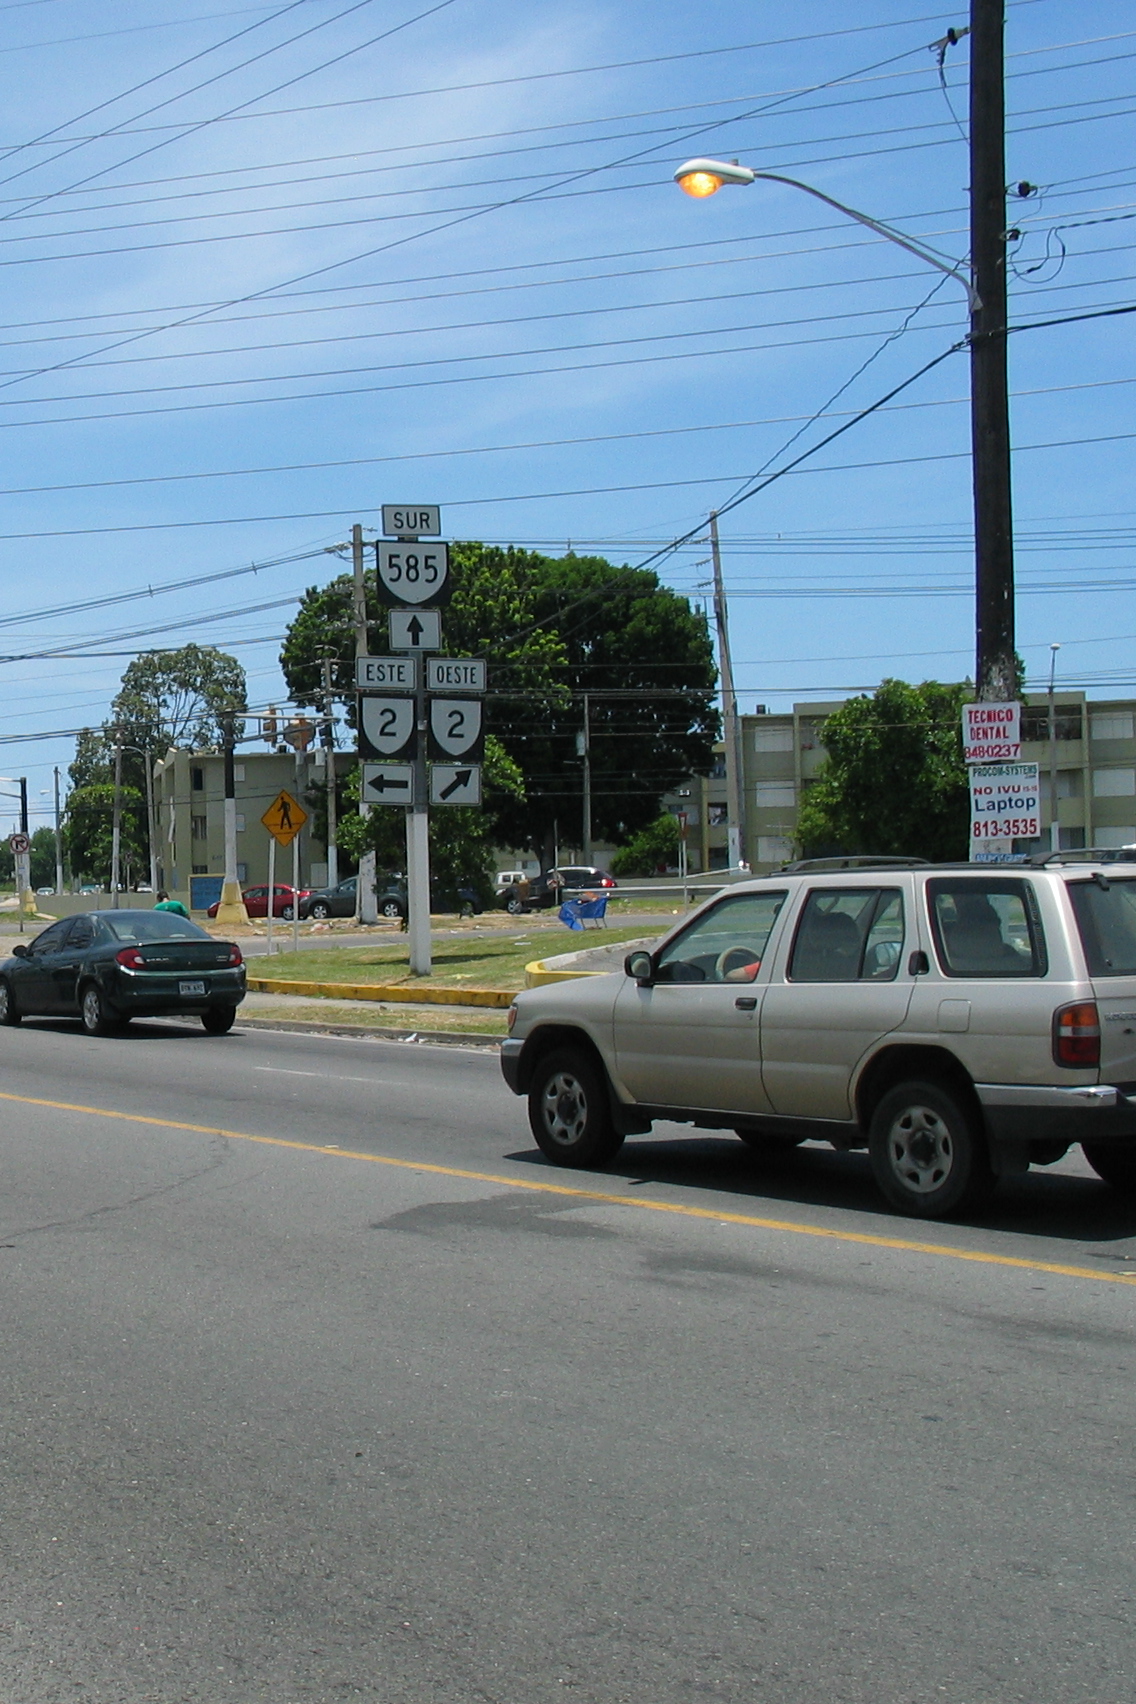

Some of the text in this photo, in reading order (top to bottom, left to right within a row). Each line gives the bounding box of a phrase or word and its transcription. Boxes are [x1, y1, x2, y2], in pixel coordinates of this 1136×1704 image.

[393, 512, 431, 530] SUR
[387, 554, 439, 584] 585
[365, 664, 407, 683] ESTE
[436, 665, 478, 685] OESTE
[378, 708, 398, 738] 2
[447, 709, 466, 739] 2
[967, 708, 1014, 725] TECNICO
[969, 726, 1010, 741] DENTAL
[973, 786, 993, 796] NO
[998, 784, 1021, 795] IVU
[974, 796, 1036, 814] Laptop
[973, 818, 1038, 838] 813-3535
